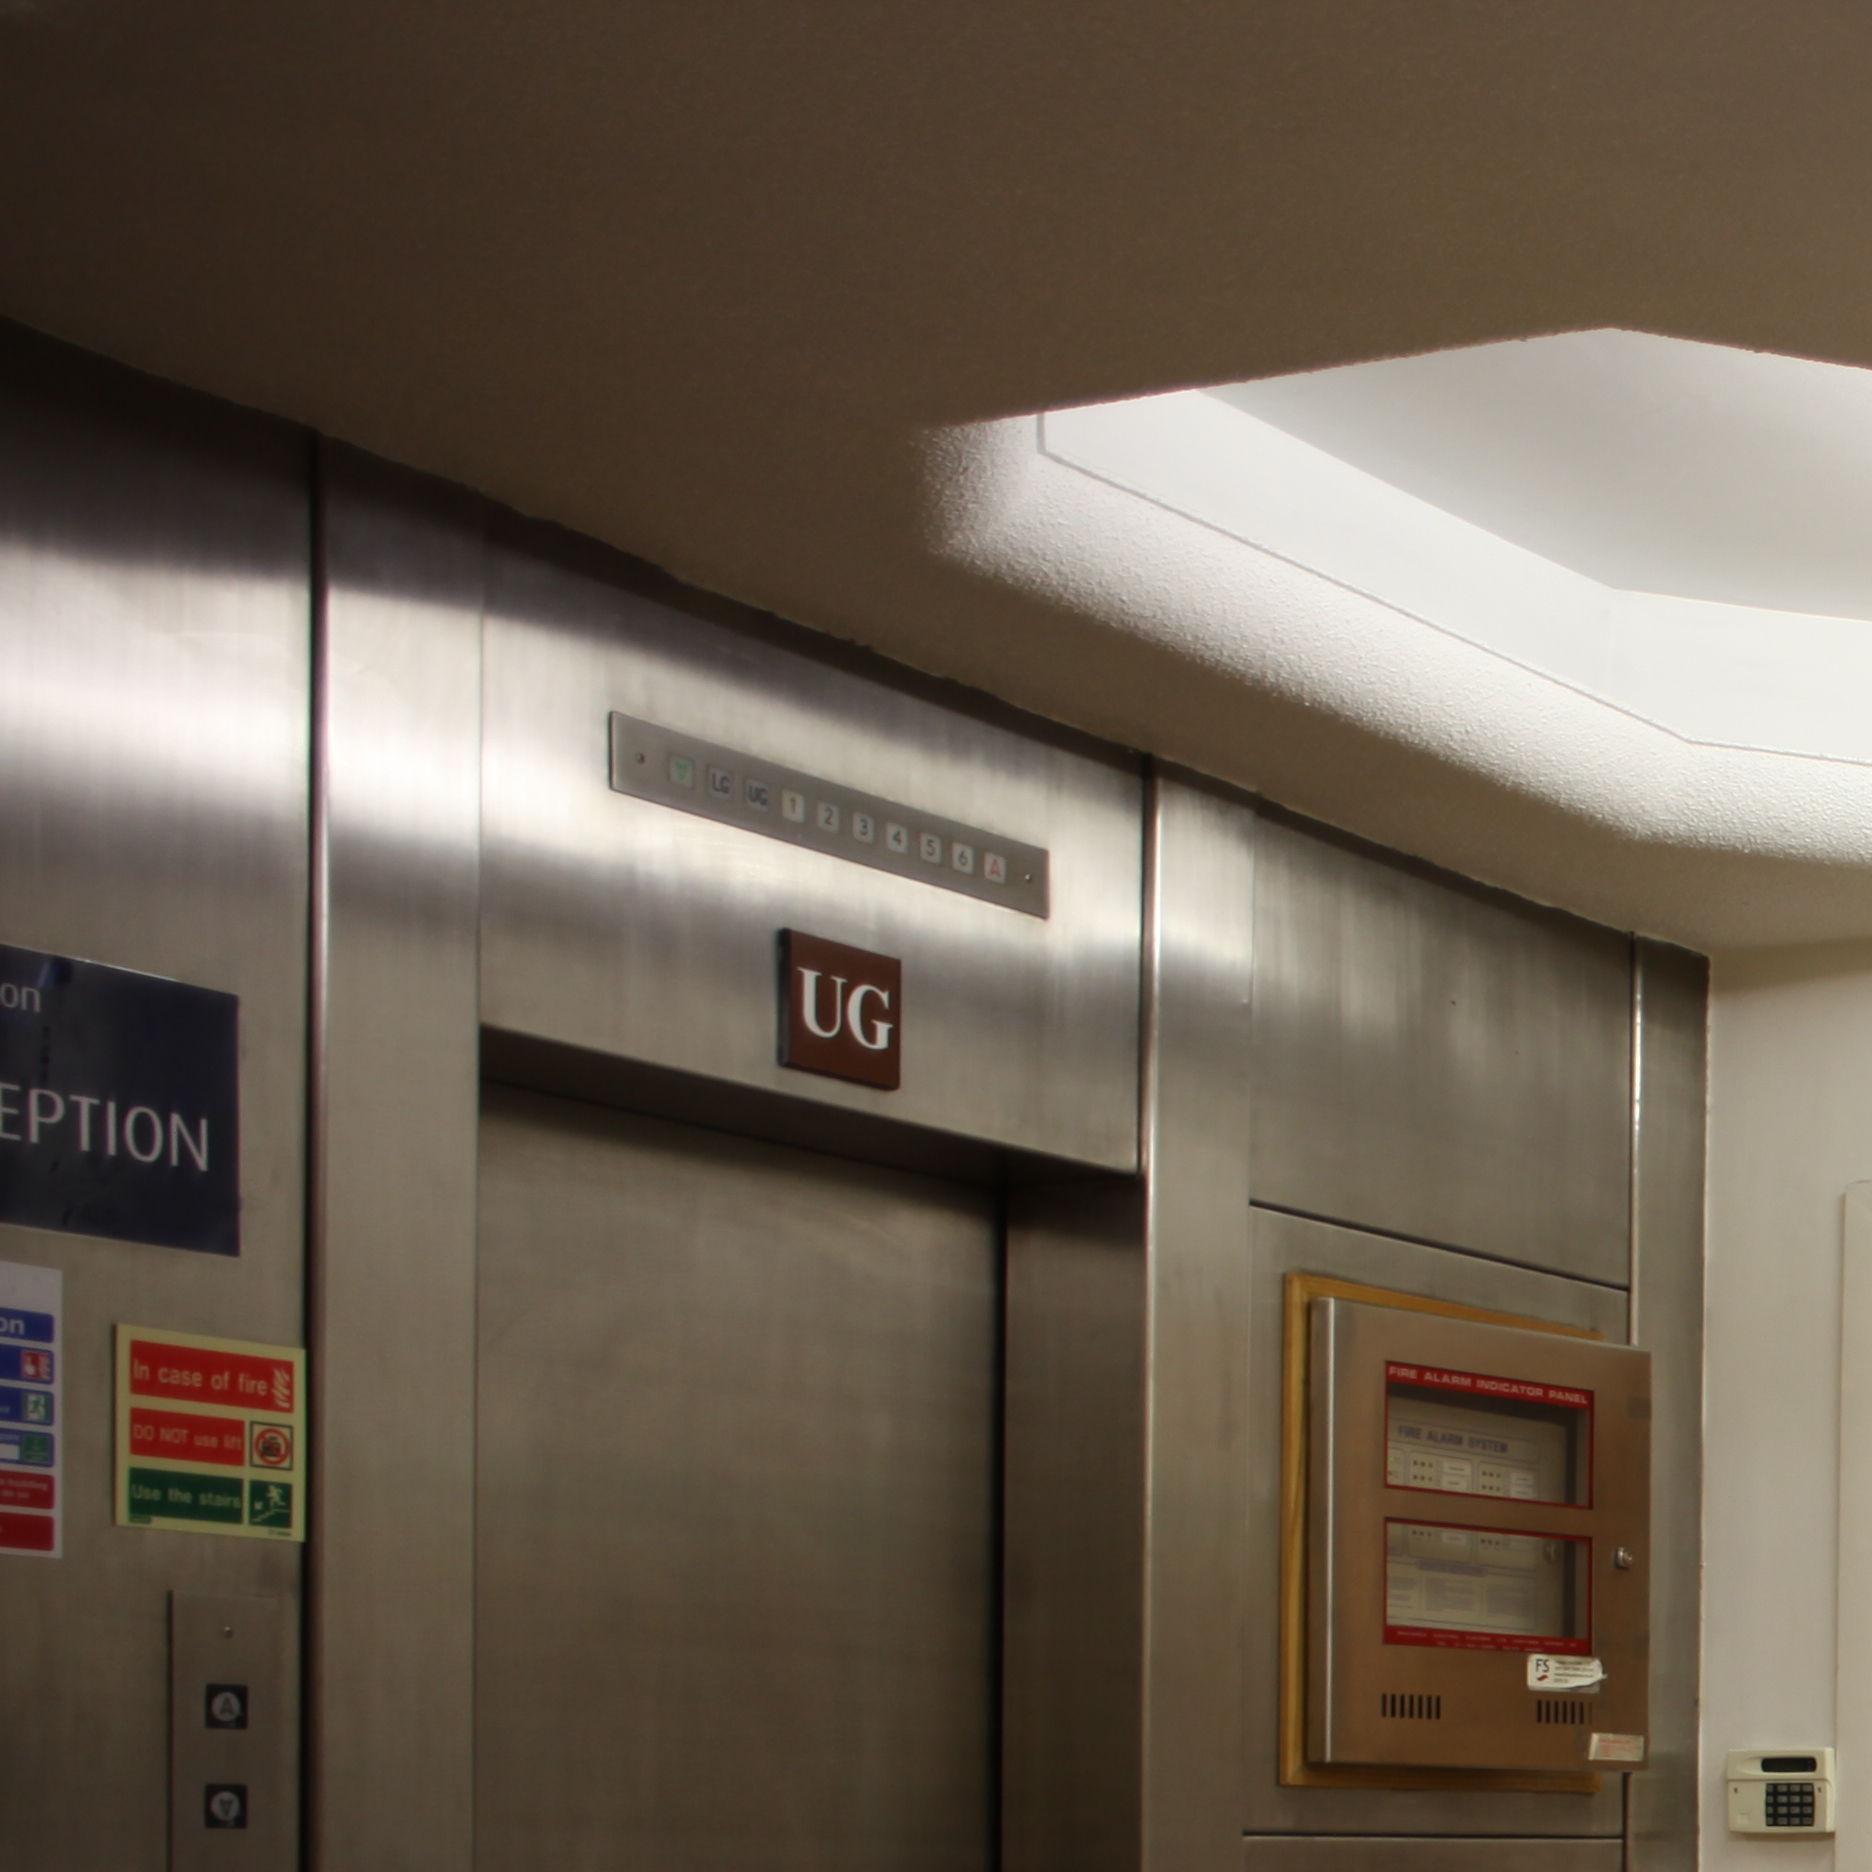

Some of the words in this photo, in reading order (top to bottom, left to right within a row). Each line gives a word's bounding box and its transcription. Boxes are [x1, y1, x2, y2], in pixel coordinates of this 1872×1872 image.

[823, 807, 834, 826] 2
[859, 818, 869, 837] 3
[892, 829, 903, 846] 4
[926, 838, 937, 856] 5
[959, 850, 970, 867] 6
[797, 967, 894, 1050] UG
[0, 1082, 208, 1171] EPTION
[132, 1359, 150, 1380] In
[157, 1367, 203, 1388] case
[210, 1371, 231, 1391] of
[238, 1373, 269, 1397] fire
[1389, 1366, 1418, 1379] FIRE
[1424, 1371, 1472, 1387] ALARM
[1476, 1379, 1544, 1397] INDICATOR
[1549, 1389, 1589, 1405] PANEL
[132, 1424, 155, 1441] DO
[160, 1427, 190, 1444] NOT
[1397, 1425, 1422, 1440] FIRE
[1427, 1431, 1463, 1446] ALARM
[1468, 1437, 1508, 1453] SYSTEM
[131, 1485, 161, 1501] Use
[167, 1487, 193, 1504] the
[199, 1491, 242, 1508] stairs
[1536, 1658, 1550, 1673] FS
